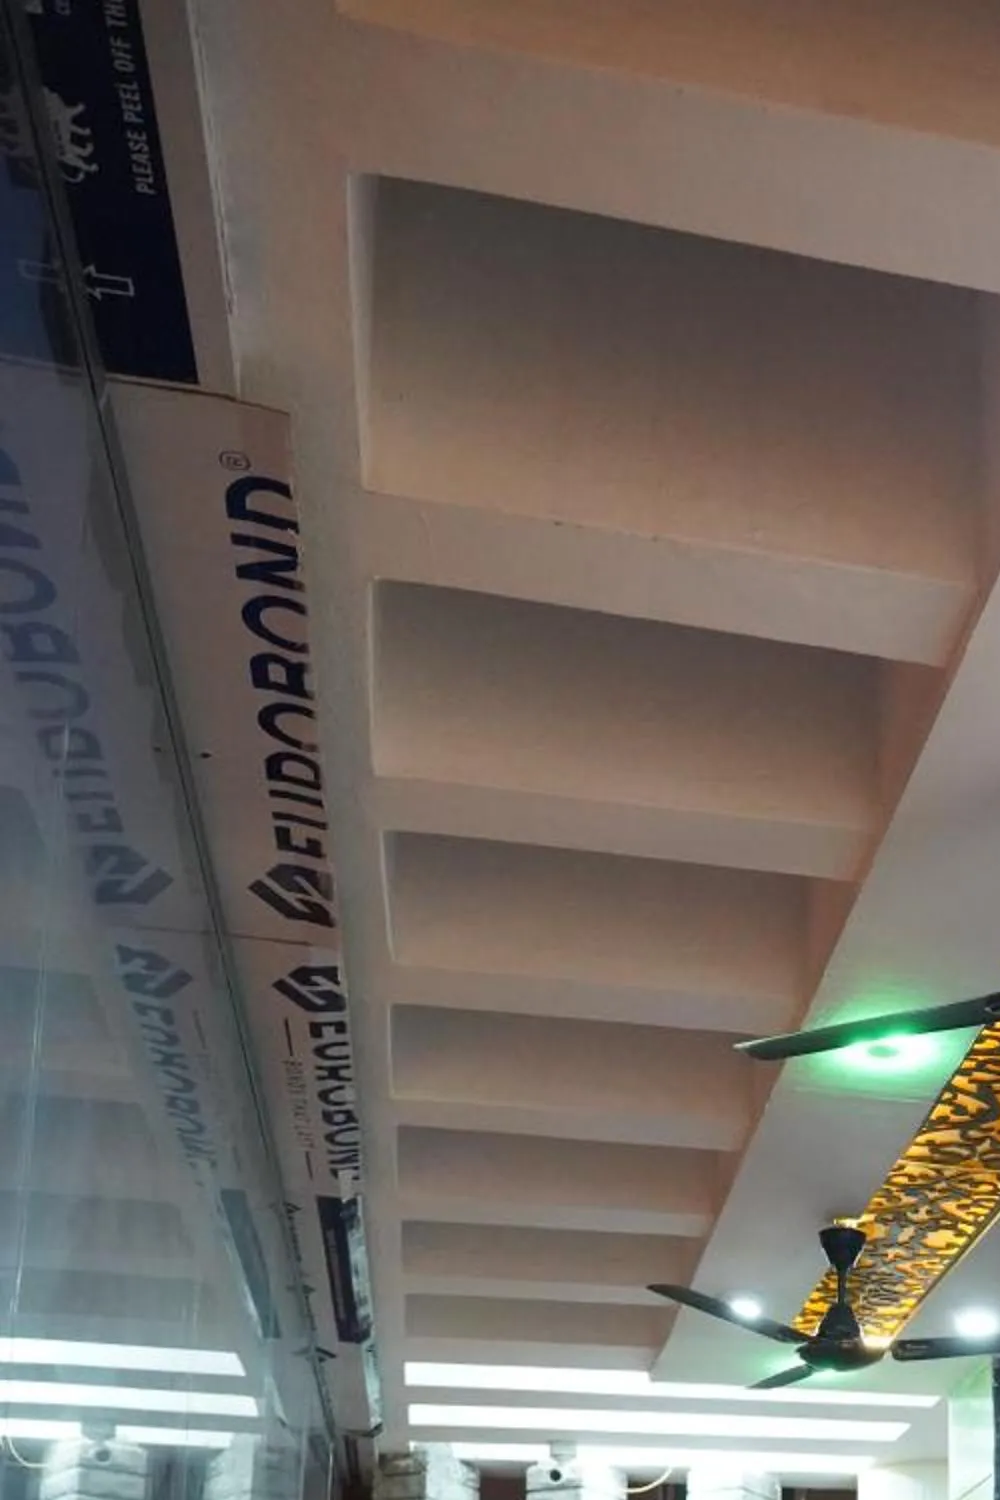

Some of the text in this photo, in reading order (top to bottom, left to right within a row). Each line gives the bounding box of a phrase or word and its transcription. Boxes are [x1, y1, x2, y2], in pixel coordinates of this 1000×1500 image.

[104, 0, 157, 195] PLEASE PEEL OFF TH
